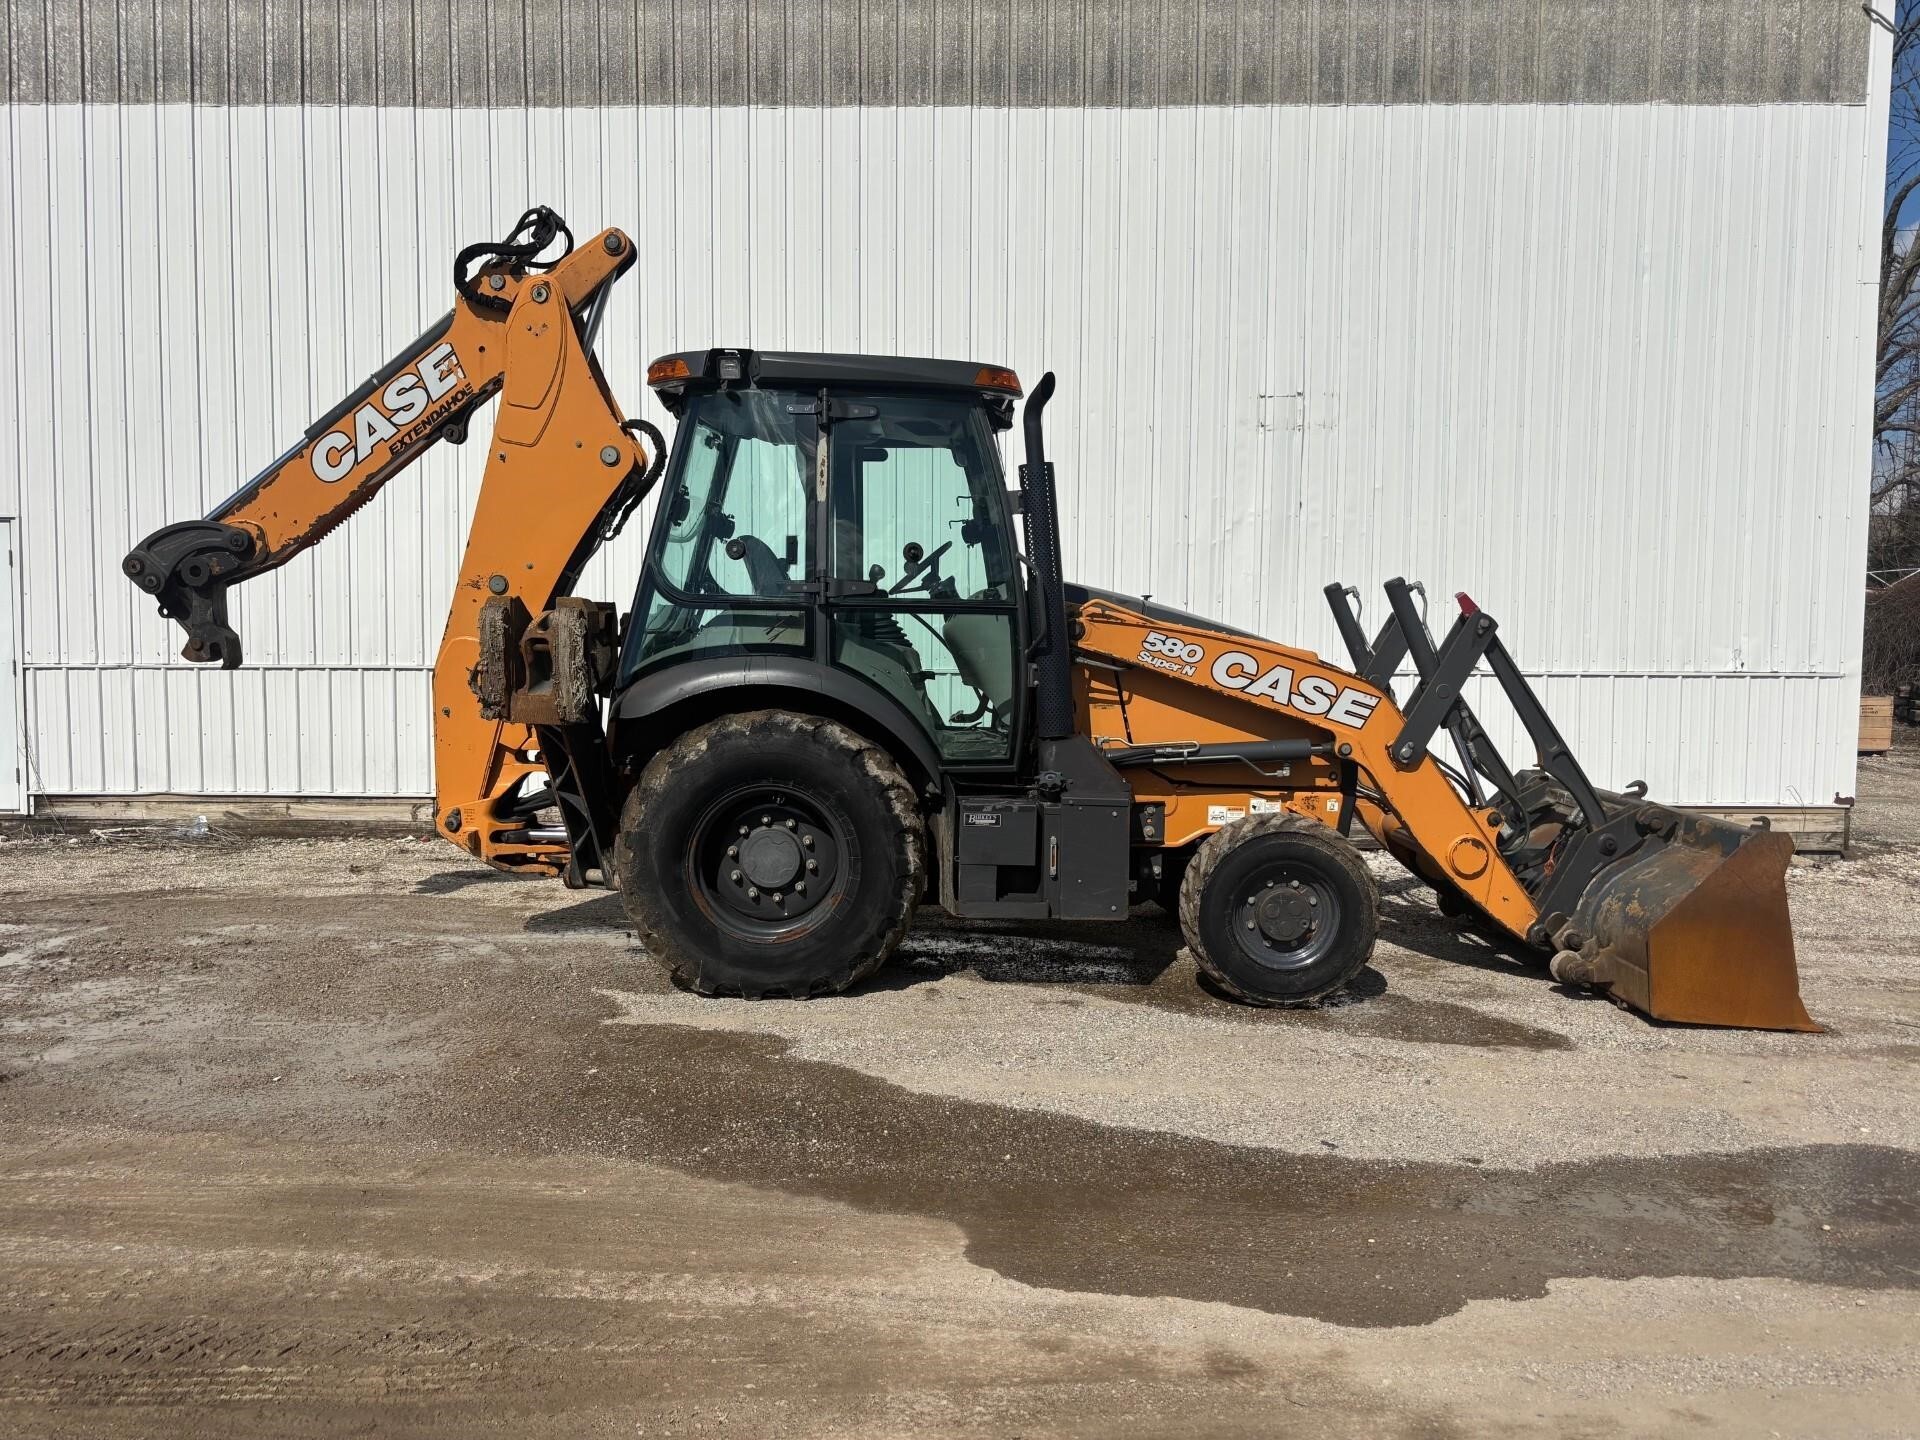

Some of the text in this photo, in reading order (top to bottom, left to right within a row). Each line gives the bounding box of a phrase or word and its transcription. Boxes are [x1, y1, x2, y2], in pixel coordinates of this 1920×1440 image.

[310, 342, 467, 483] CASE
[388, 382, 474, 456] EXTENDAHOE
[1136, 650, 1198, 677] Super N
[1141, 630, 1205, 664] 580
[1210, 651, 1382, 730] CASE
